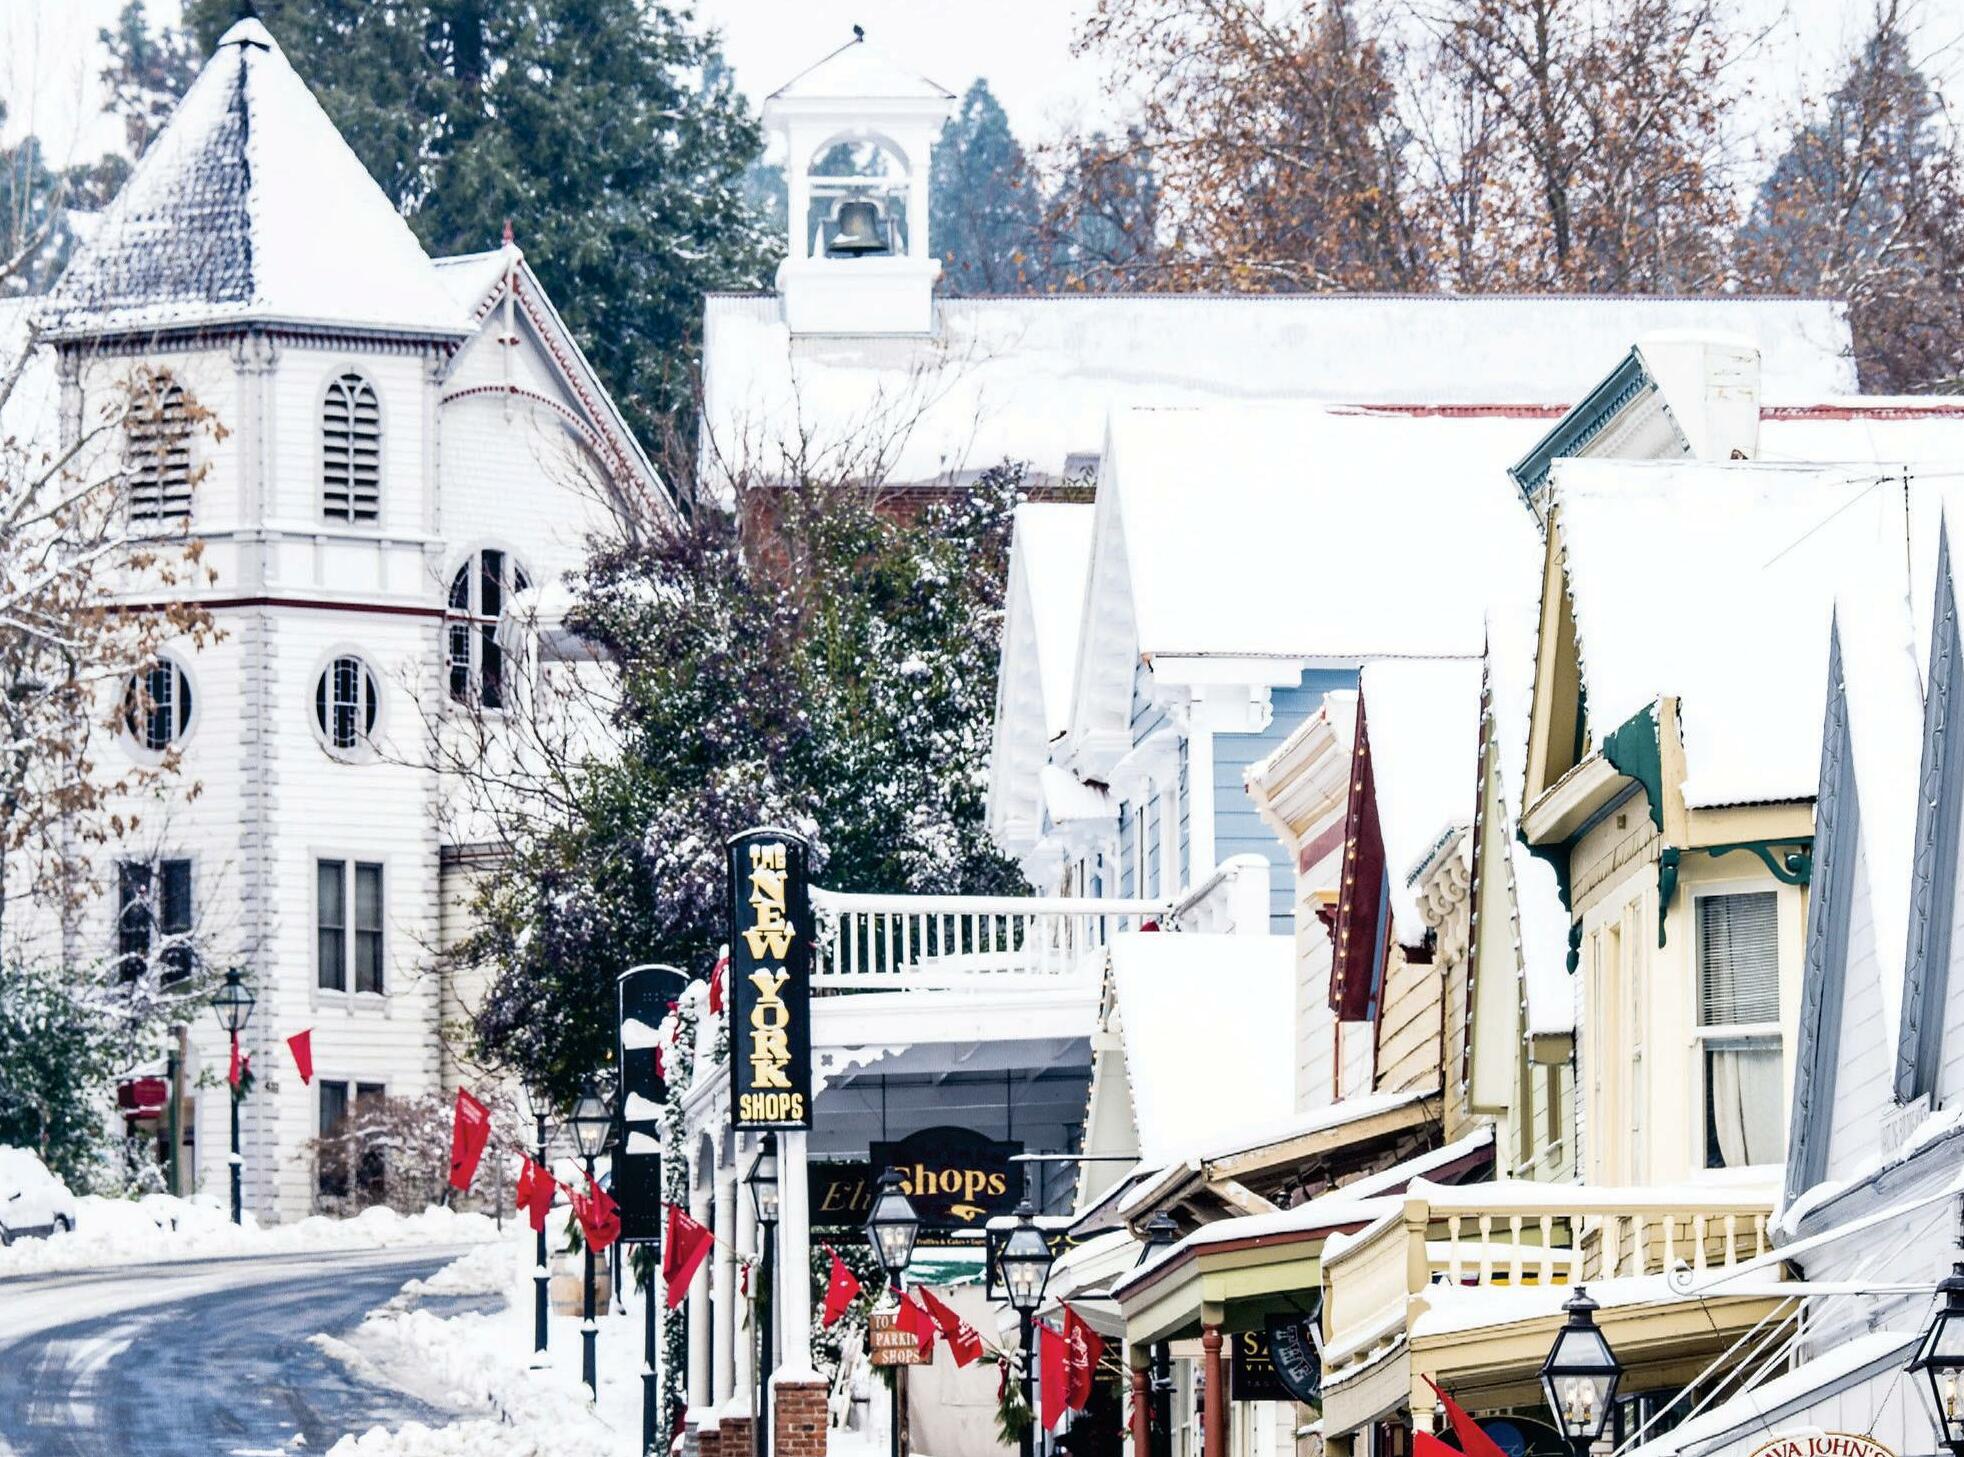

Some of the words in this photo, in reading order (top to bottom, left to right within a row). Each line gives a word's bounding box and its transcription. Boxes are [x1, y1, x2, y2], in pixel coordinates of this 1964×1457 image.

[748, 843, 787, 869] THE
[742, 870, 796, 960] NEW
[748, 968, 793, 1088] YORK
[740, 1092, 804, 1121] SHOPS
[895, 1163, 1006, 1201] Shops
[876, 1315, 889, 1328] TO
[876, 1332, 918, 1346] PARKIN
[882, 1349, 920, 1364] SHOPS
